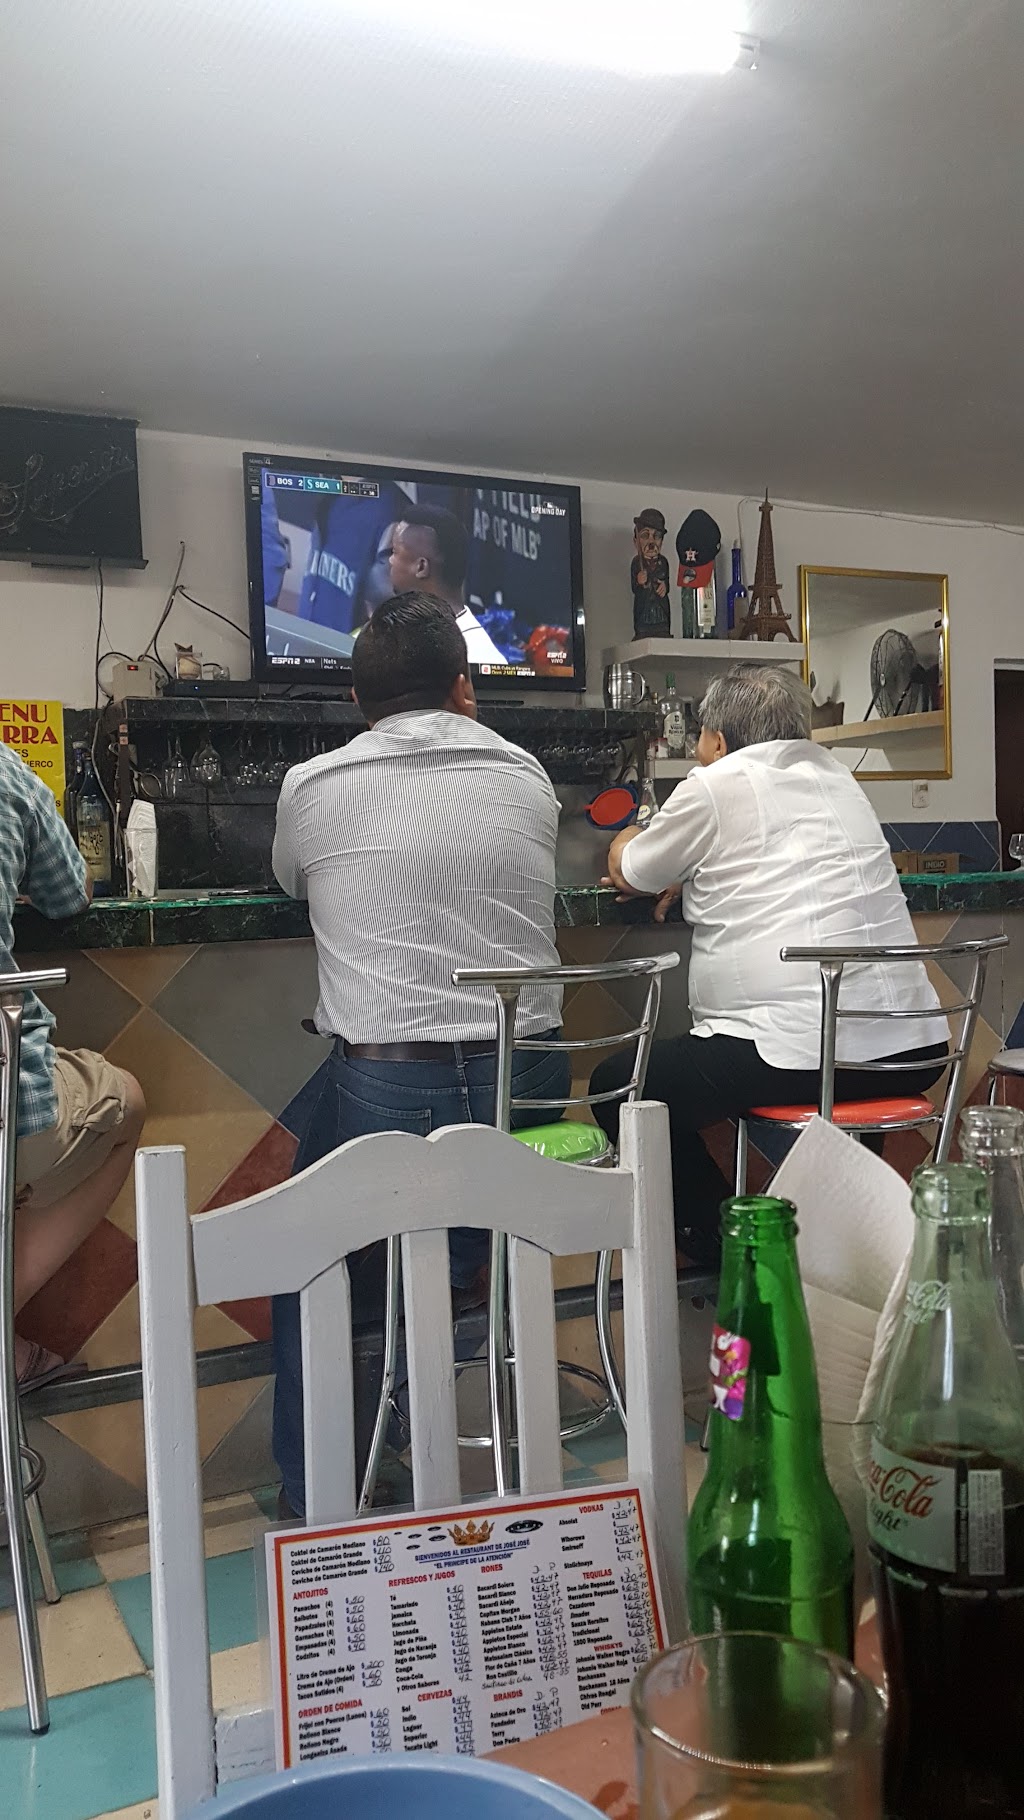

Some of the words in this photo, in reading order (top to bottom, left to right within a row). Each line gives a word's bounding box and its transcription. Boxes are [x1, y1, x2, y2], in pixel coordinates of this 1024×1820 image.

[277, 477, 293, 486] BOS
[298, 479, 303, 487] 2
[315, 481, 329, 489] SEA
[531, 506, 555, 515] OPENING
[555, 507, 566, 516] DAY
[493, 515, 508, 549] OF
[925, 860, 945, 869] INDIO
[579, 1504, 603, 1514] VODKAS
[415, 1551, 450, 1561] BIENVENIDOS
[460, 1545, 494, 1555] RESTAURANT
[481, 1564, 503, 1573] RONES
[389, 1574, 427, 1587] REFRESCOS
[435, 1571, 455, 1580] JUGOS
[583, 1569, 612, 1580] TEQUILAS
[293, 1588, 328, 1600] ANTOJITOS
[594, 1642, 623, 1651] WHISKYS
[418, 1689, 452, 1702] CERVEZAS
[298, 1706, 322, 1718] ORDEN
[325, 1704, 333, 1713] DE
[335, 1699, 362, 1711] COMIDA
